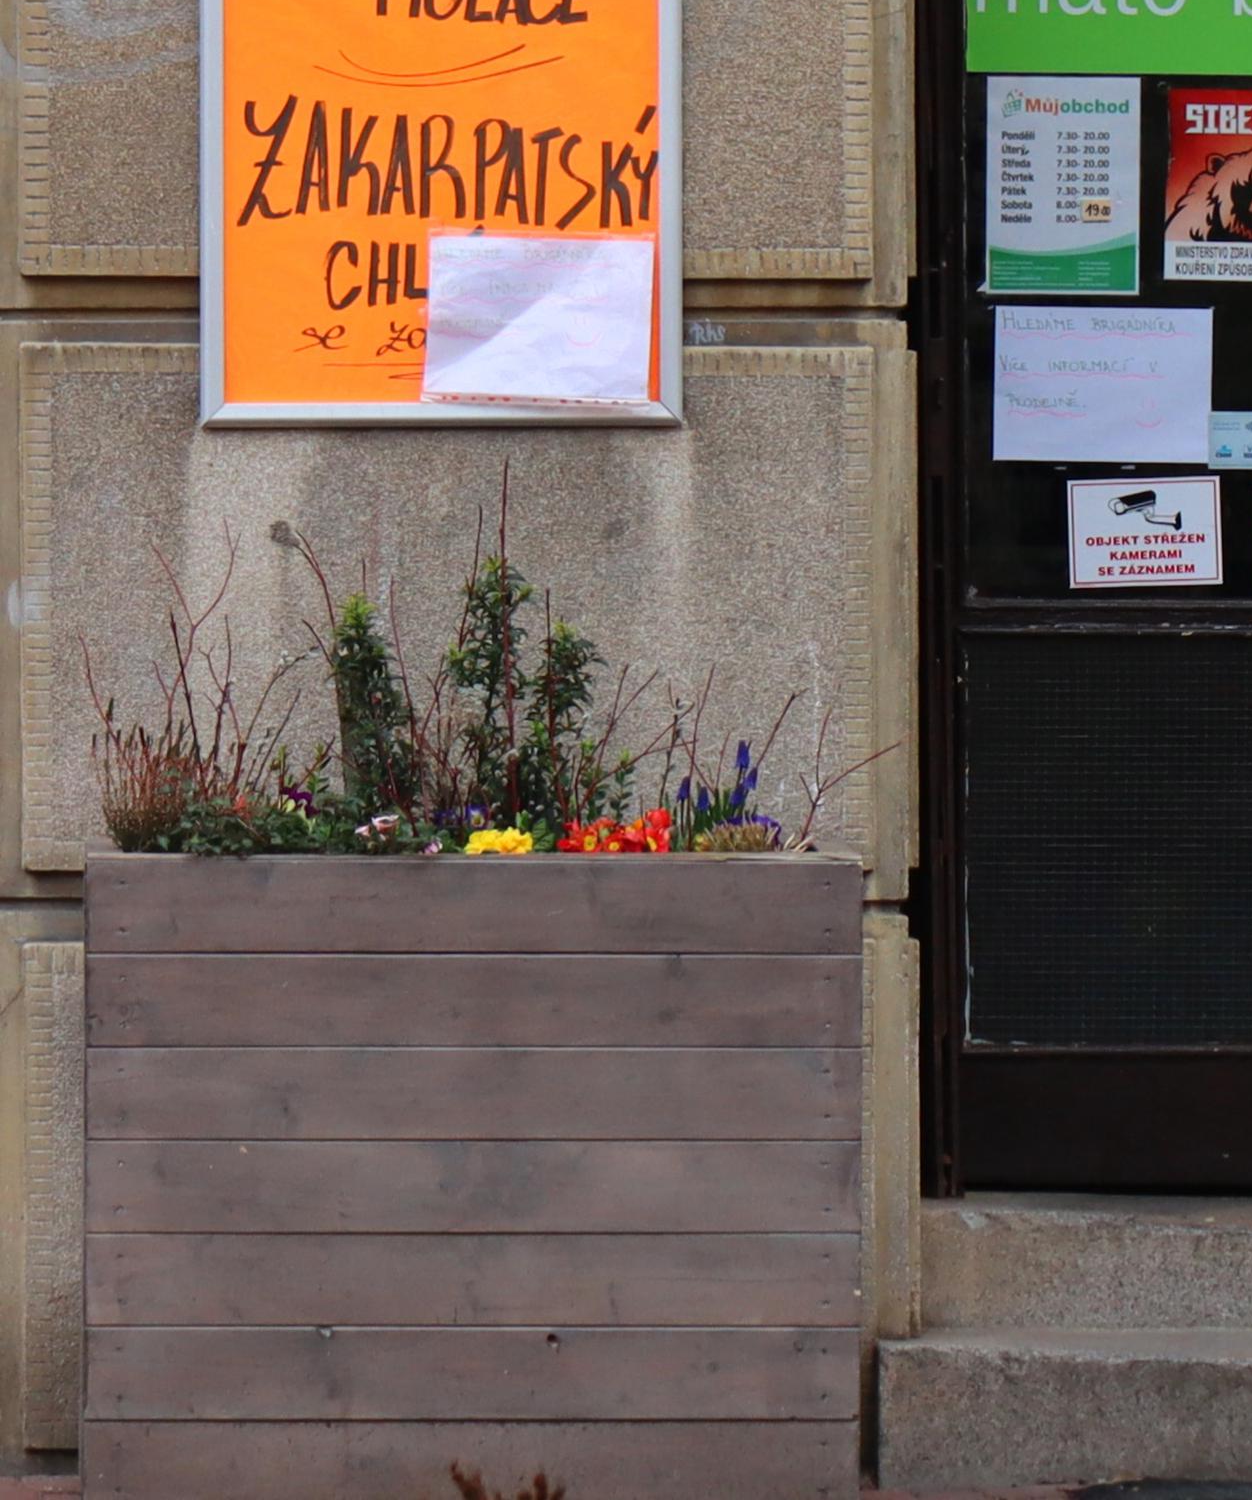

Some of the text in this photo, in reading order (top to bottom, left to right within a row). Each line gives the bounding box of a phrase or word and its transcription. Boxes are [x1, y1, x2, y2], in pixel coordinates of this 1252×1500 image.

[237, 94, 659, 230] ZAKARPATSKÝ
[325, 240, 428, 311] CHL
[1086, 532, 1206, 546] OBJEKT STŘEŽEN
[1109, 549, 1182, 561] KAMERAMI
[1098, 563, 1196, 576] SE ZÁZNAMEM
